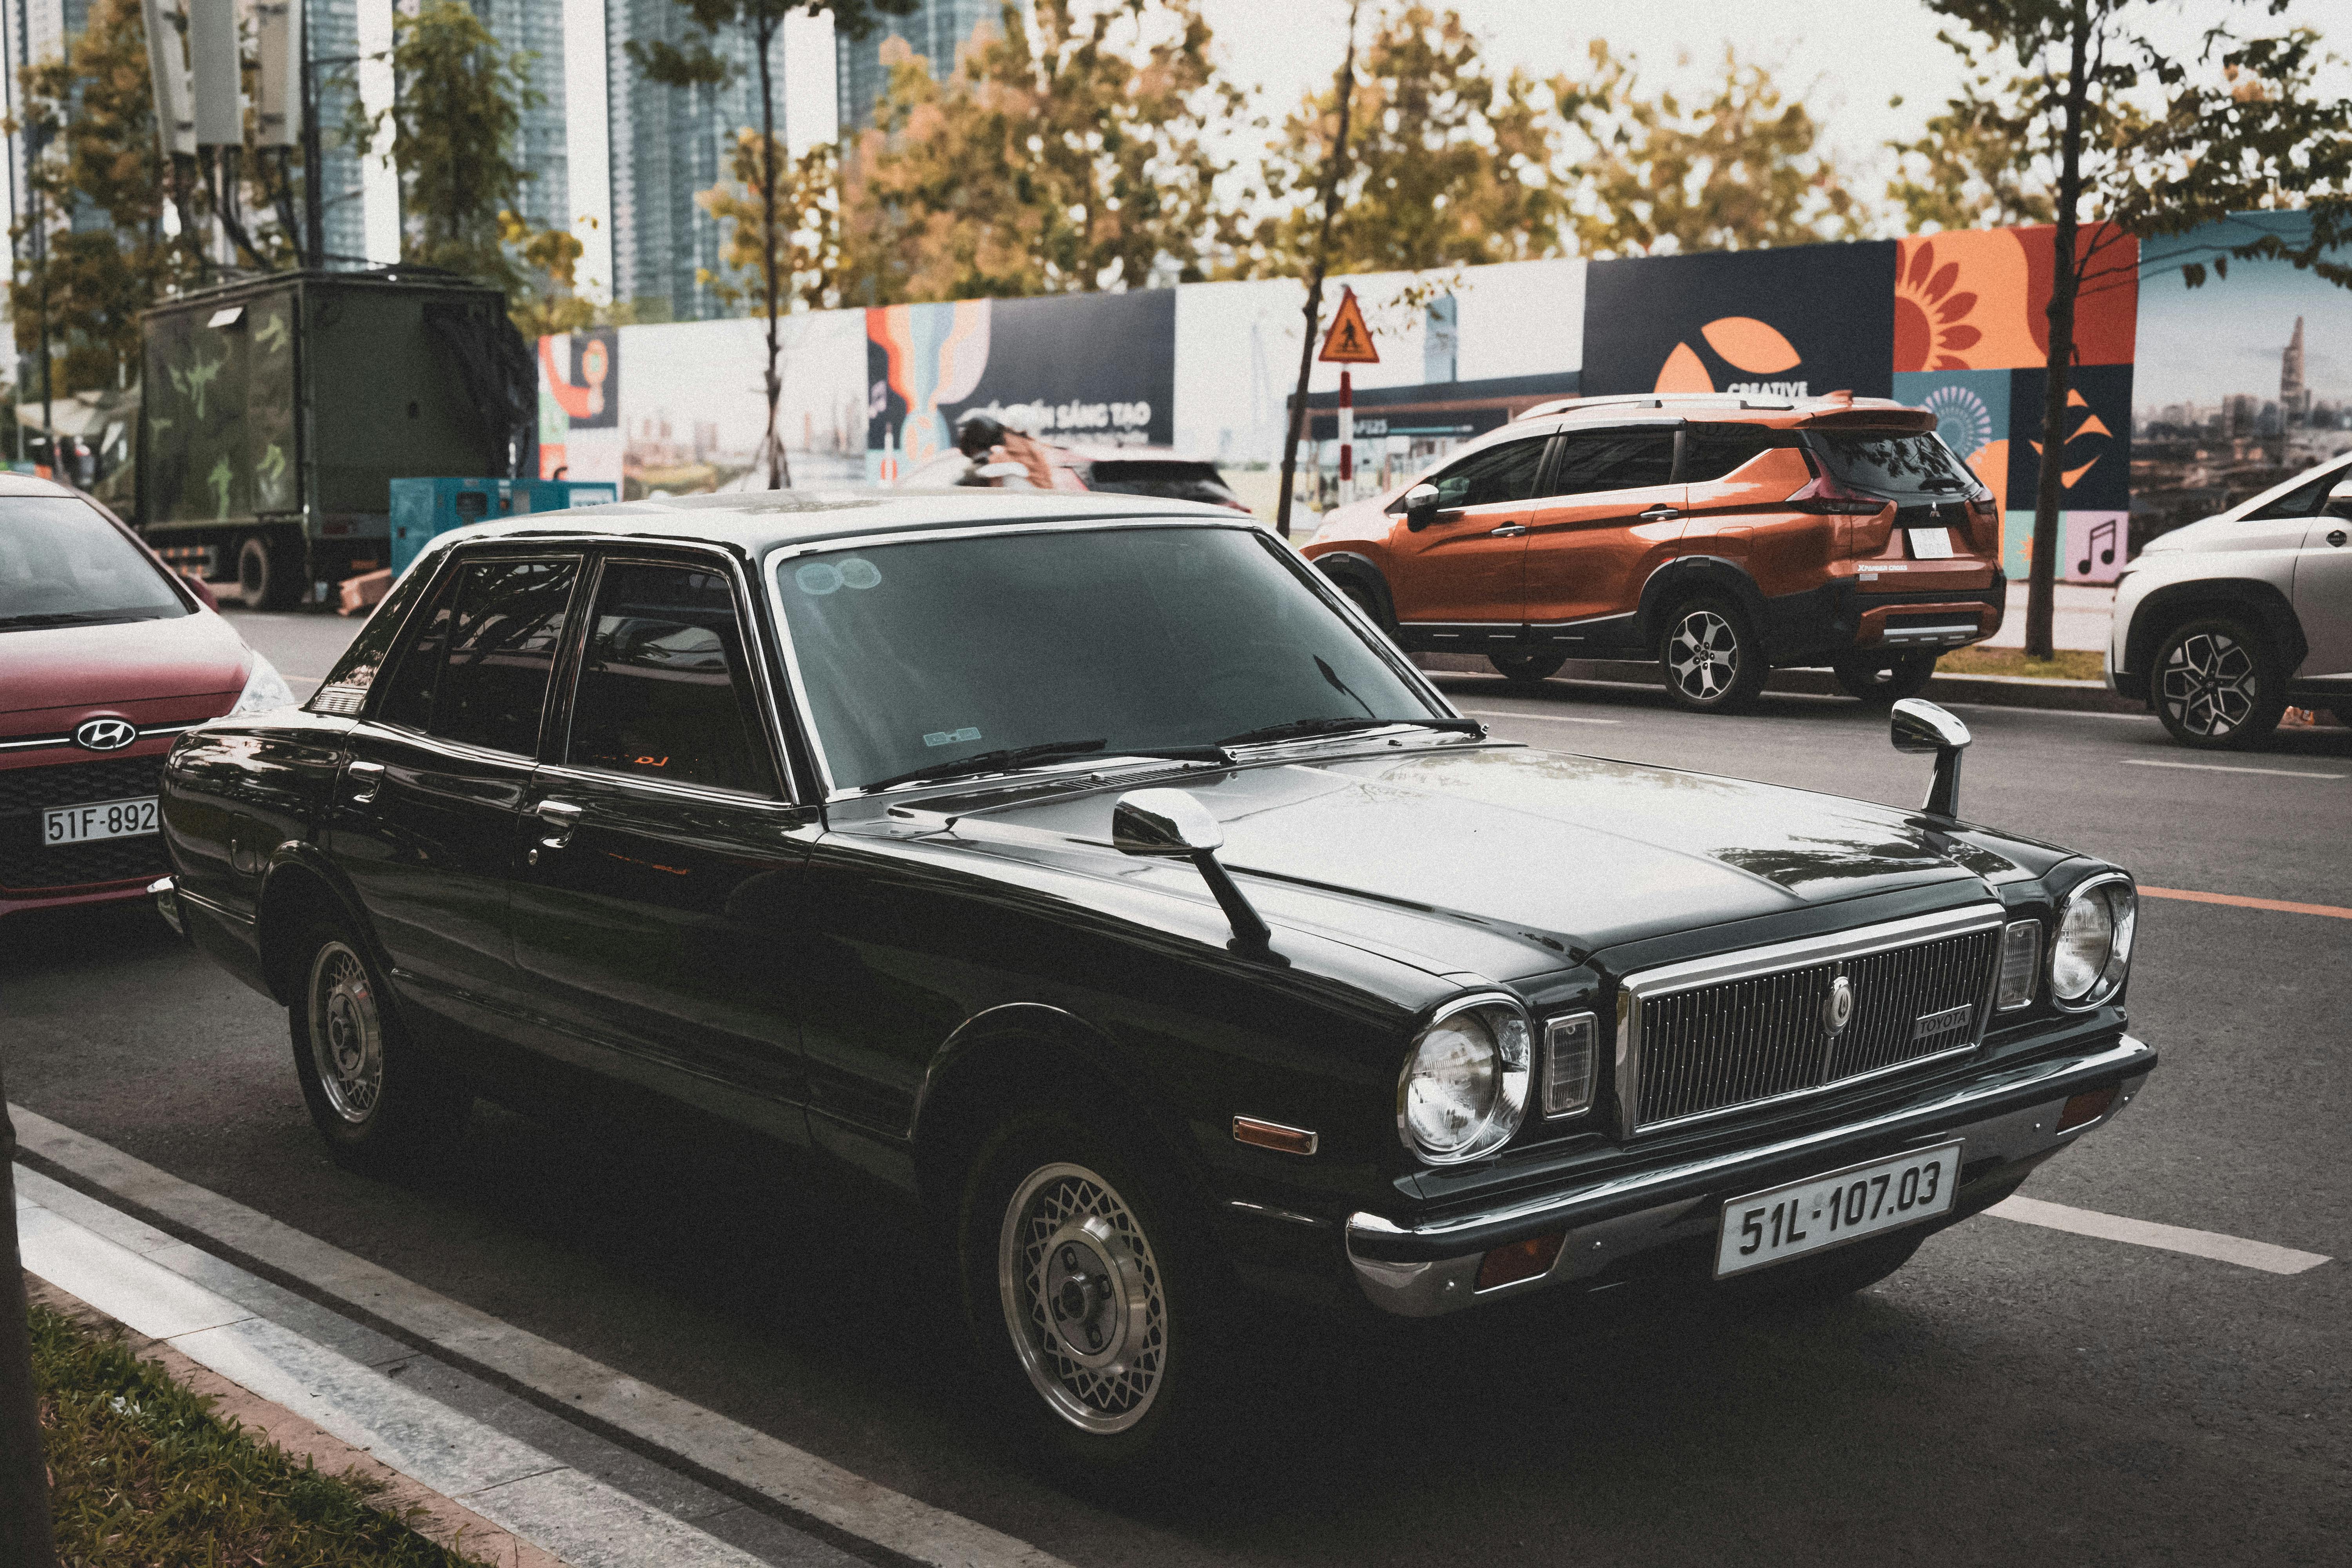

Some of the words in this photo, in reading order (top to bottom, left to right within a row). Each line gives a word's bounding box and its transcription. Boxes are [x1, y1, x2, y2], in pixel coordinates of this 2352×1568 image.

[1727, 381, 1808, 397] CREATIVE
[1920, 1009, 1967, 1034] TOYOTA
[1740, 1160, 1941, 1255] 51L-107.03
